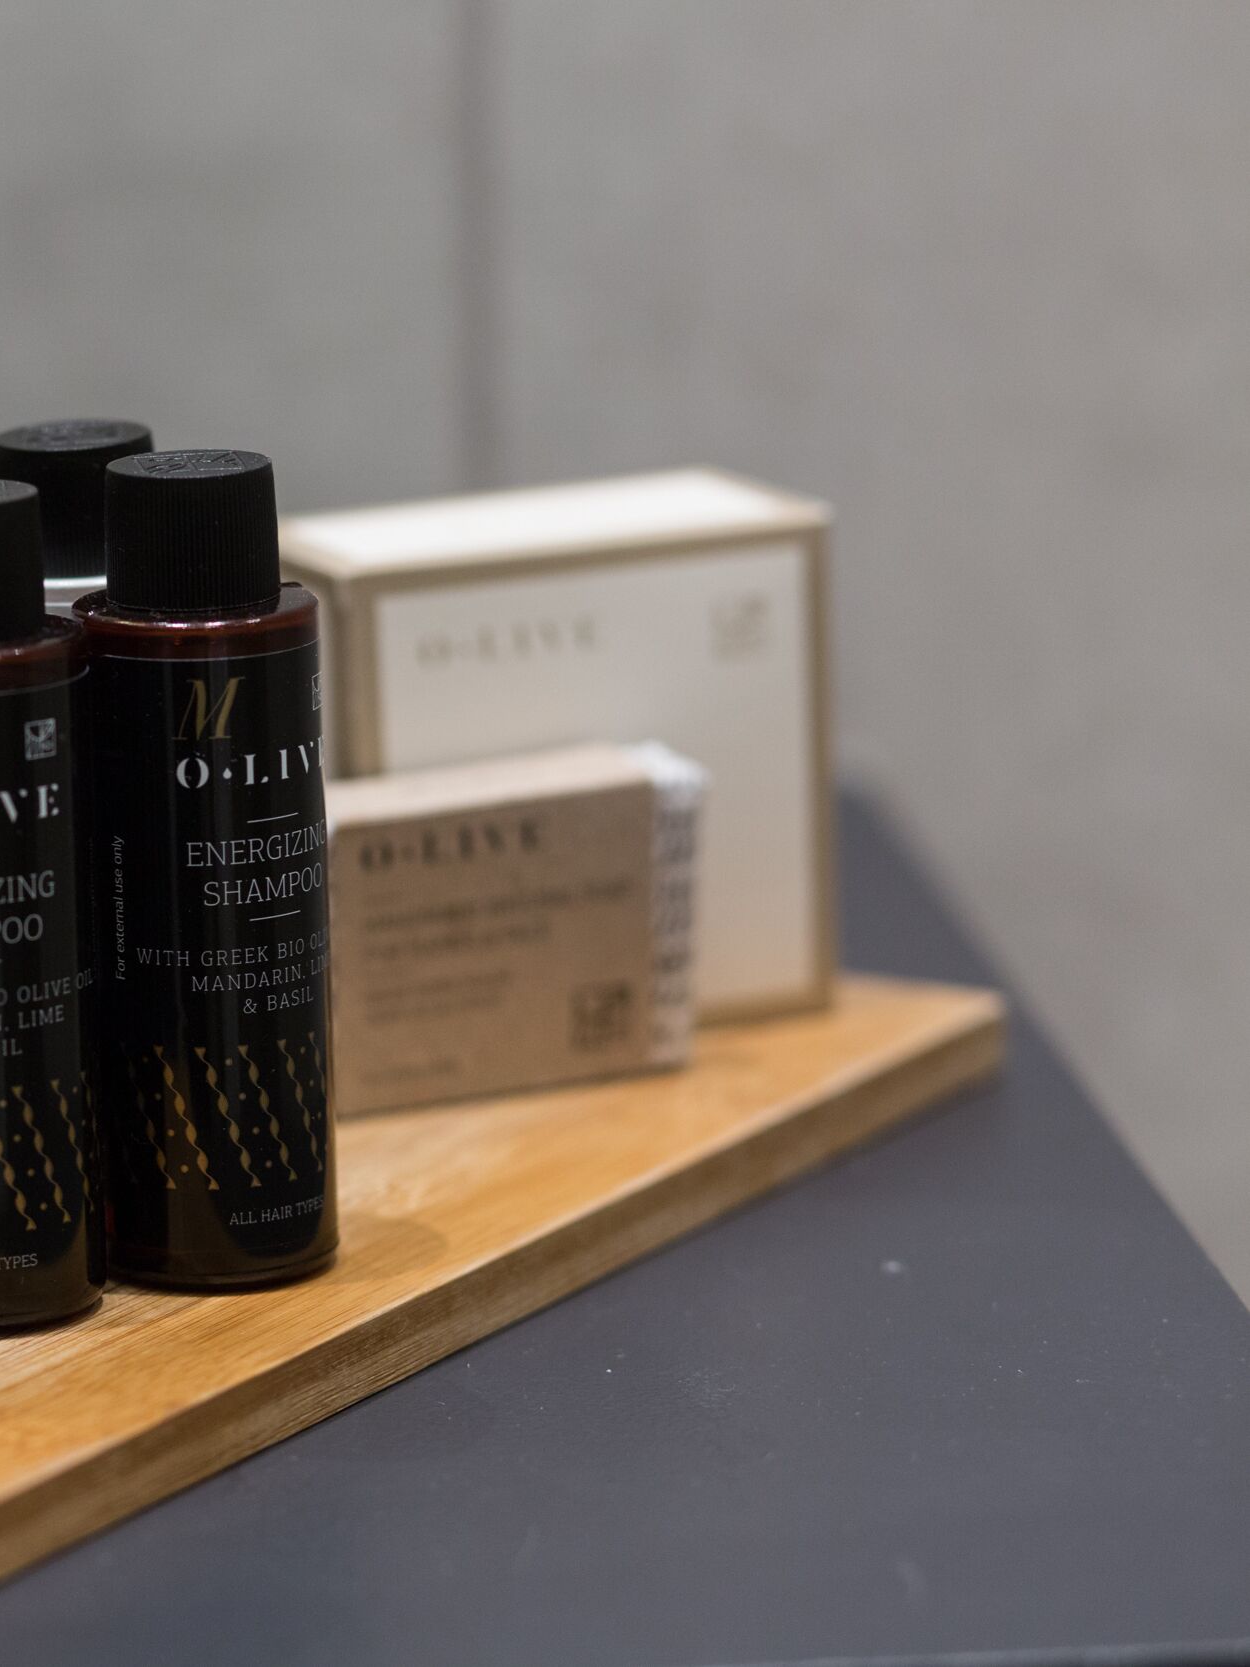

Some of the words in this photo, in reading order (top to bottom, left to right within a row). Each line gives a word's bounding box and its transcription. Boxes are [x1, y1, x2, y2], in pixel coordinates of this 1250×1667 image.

[173, 676, 246, 741] M
[111, 834, 127, 865] only
[186, 819, 326, 868] ENERGIZING
[114, 868, 125, 894] use
[203, 862, 323, 907] SHAMPOO
[112, 896, 126, 954] external
[136, 946, 191, 968] WITH
[200, 945, 269, 968] GREEK
[277, 937, 305, 960] BIO
[114, 955, 127, 982] For
[16, 976, 71, 1004] OLIVE
[243, 998, 258, 1015] &
[266, 986, 314, 1012] BASIL
[17, 1004, 65, 1030] LIME
[230, 1211, 258, 1226] ALL
[261, 1204, 293, 1223] HAIR
